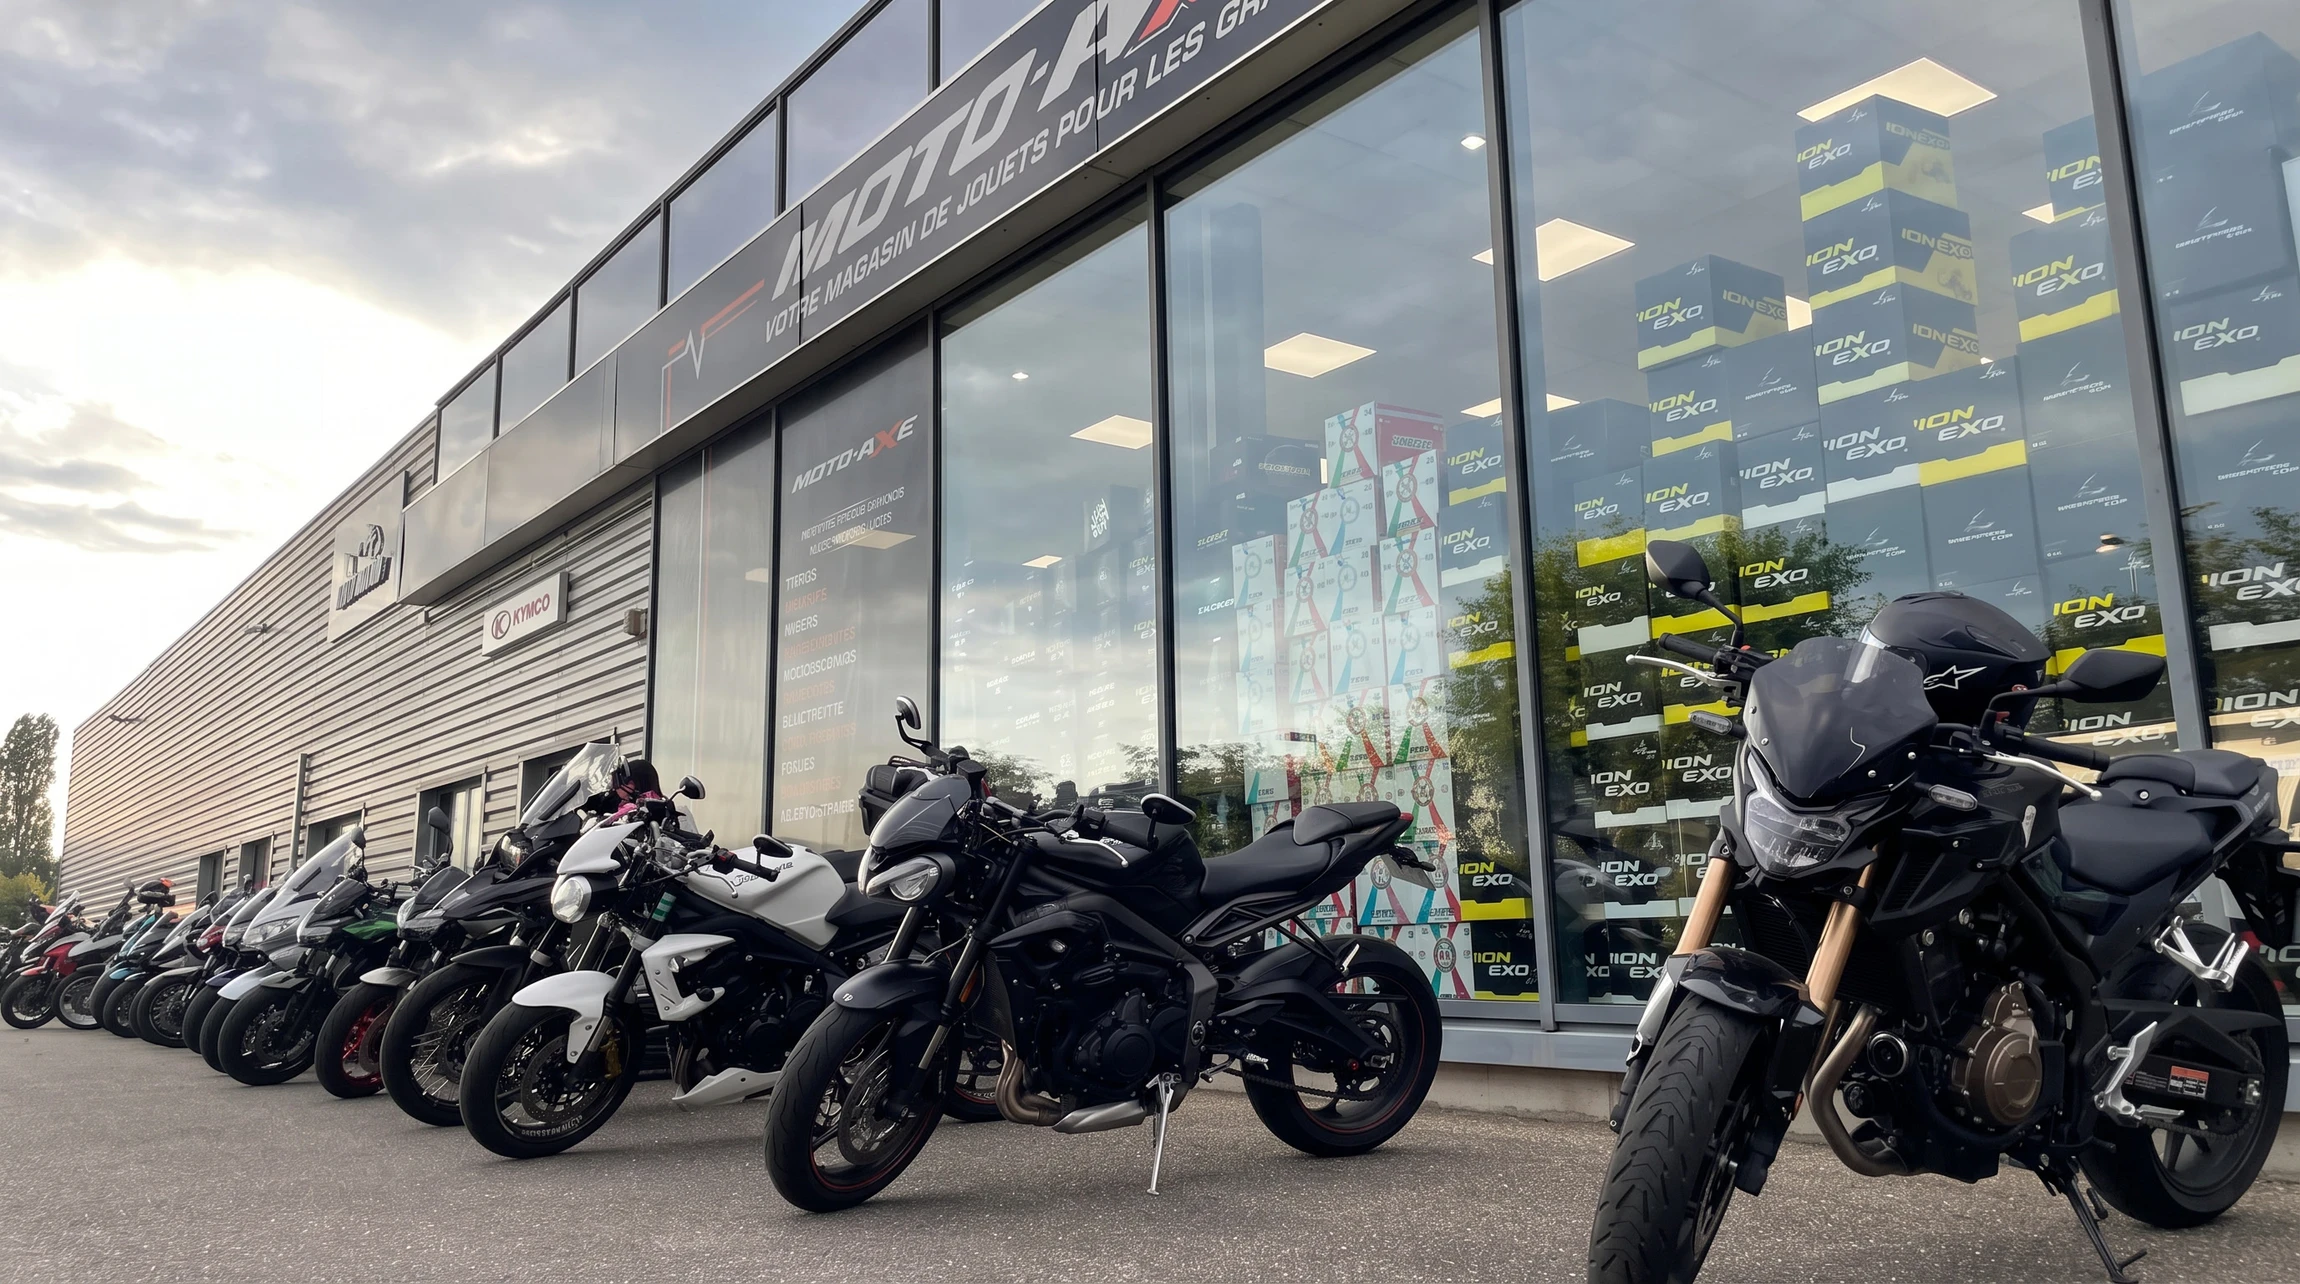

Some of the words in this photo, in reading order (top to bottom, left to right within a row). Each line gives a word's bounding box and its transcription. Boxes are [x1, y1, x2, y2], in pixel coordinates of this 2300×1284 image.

[1796, 138, 1833, 163] ION
[1808, 143, 1851, 170] EXO
[765, 286, 821, 343] VOTRE
[824, 220, 917, 305] MAGASIN
[920, 195, 952, 240] DE
[956, 128, 1050, 216] JOUETS
[1055, 67, 1138, 149] POUR
[1145, 20, 1206, 90] LES
[1805, 238, 1854, 267] ION
[1822, 245, 1878, 275] EXO
[2015, 255, 2074, 288] ION
[2036, 262, 2104, 296] EXO
[1638, 297, 1681, 322] ION
[1653, 304, 1703, 330] EXO
[2173, 317, 2230, 341] ION
[2193, 325, 2259, 351] EXO
[1816, 331, 1865, 357] ION
[1832, 338, 1891, 366] EXO
[1652, 390, 1695, 413] ION
[1666, 398, 1717, 422] EXO
[1917, 405, 1975, 431] ION
[1938, 414, 2004, 442] EXO
[1826, 426, 1881, 450] ION
[1846, 436, 1907, 461] EXO
[791, 414, 918, 494] MOTO-AXE
[1450, 447, 1485, 466] ION
[1461, 454, 1502, 475] EXO
[1744, 458, 1791, 480] ION
[1759, 466, 1813, 490] EXO
[1645, 483, 1689, 503] ION
[1659, 491, 1710, 514] EXO
[1574, 497, 1604, 513] ION
[1583, 503, 1619, 520] EXO
[1443, 527, 1475, 545] ION
[1453, 536, 1490, 554] EXO
[1739, 557, 1785, 578] ION
[1754, 568, 1809, 589] EXO
[2209, 562, 2285, 587] ION
[1575, 584, 1605, 599] ION
[1586, 591, 1621, 607] EXO
[513, 593, 550, 626] KYMCO
[2053, 593, 2114, 616] ION
[1447, 611, 1481, 628] ION
[2074, 604, 2146, 629] EXO
[1460, 620, 1498, 637] EXO
[1583, 681, 1622, 698] ION
[1597, 691, 1642, 708] EXO
[2223, 688, 2299, 712] ION
[2069, 711, 2132, 732] ION
[2092, 724, 2166, 746] EXO
[1666, 754, 1713, 770] ION
[1590, 769, 1632, 785] ION
[1682, 766, 1732, 783] EXO
[1604, 781, 1650, 798] EXO
[1459, 861, 1495, 875] ION
[1600, 860, 1640, 873] ION
[1472, 873, 1513, 886] EXO
[1614, 873, 1659, 887] EXO
[1477, 952, 1511, 963] ION
[1613, 952, 1657, 965] ION
[1488, 964, 1529, 976] EXO
[1629, 966, 1663, 979] EX
